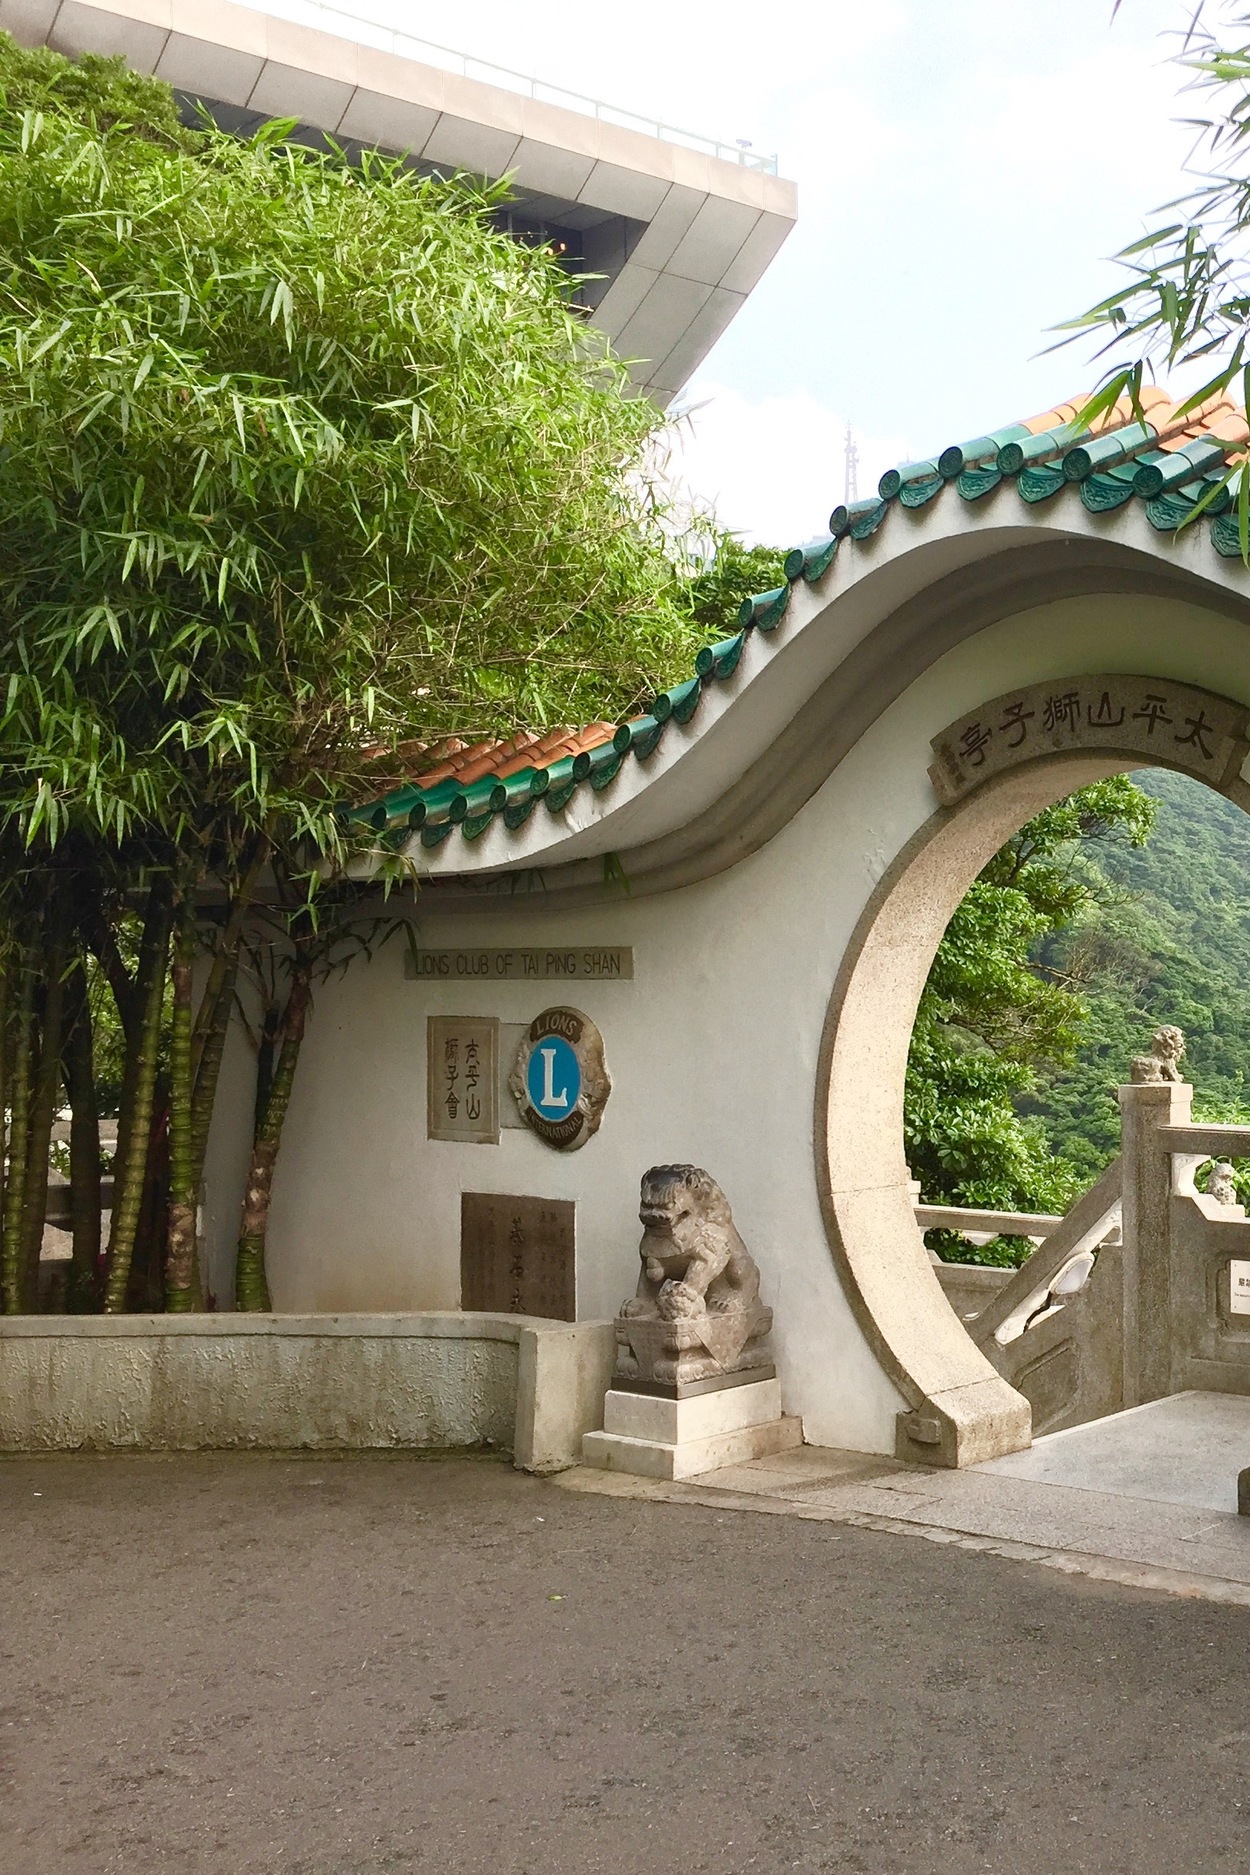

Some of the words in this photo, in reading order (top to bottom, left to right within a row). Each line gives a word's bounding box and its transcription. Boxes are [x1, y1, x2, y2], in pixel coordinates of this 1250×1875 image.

[958, 691, 1215, 767] 太平山獅子亭
[415, 955, 450, 976] LIONS
[456, 954, 489, 975] CLUB
[496, 954, 513, 975] OF
[521, 954, 539, 975] TAI
[546, 954, 576, 975] PING
[583, 953, 621, 975] SHAN
[536, 1013, 577, 1036] LIONS
[540, 1048, 568, 1107] L
[527, 1110, 582, 1139] INTERNATIONAL
